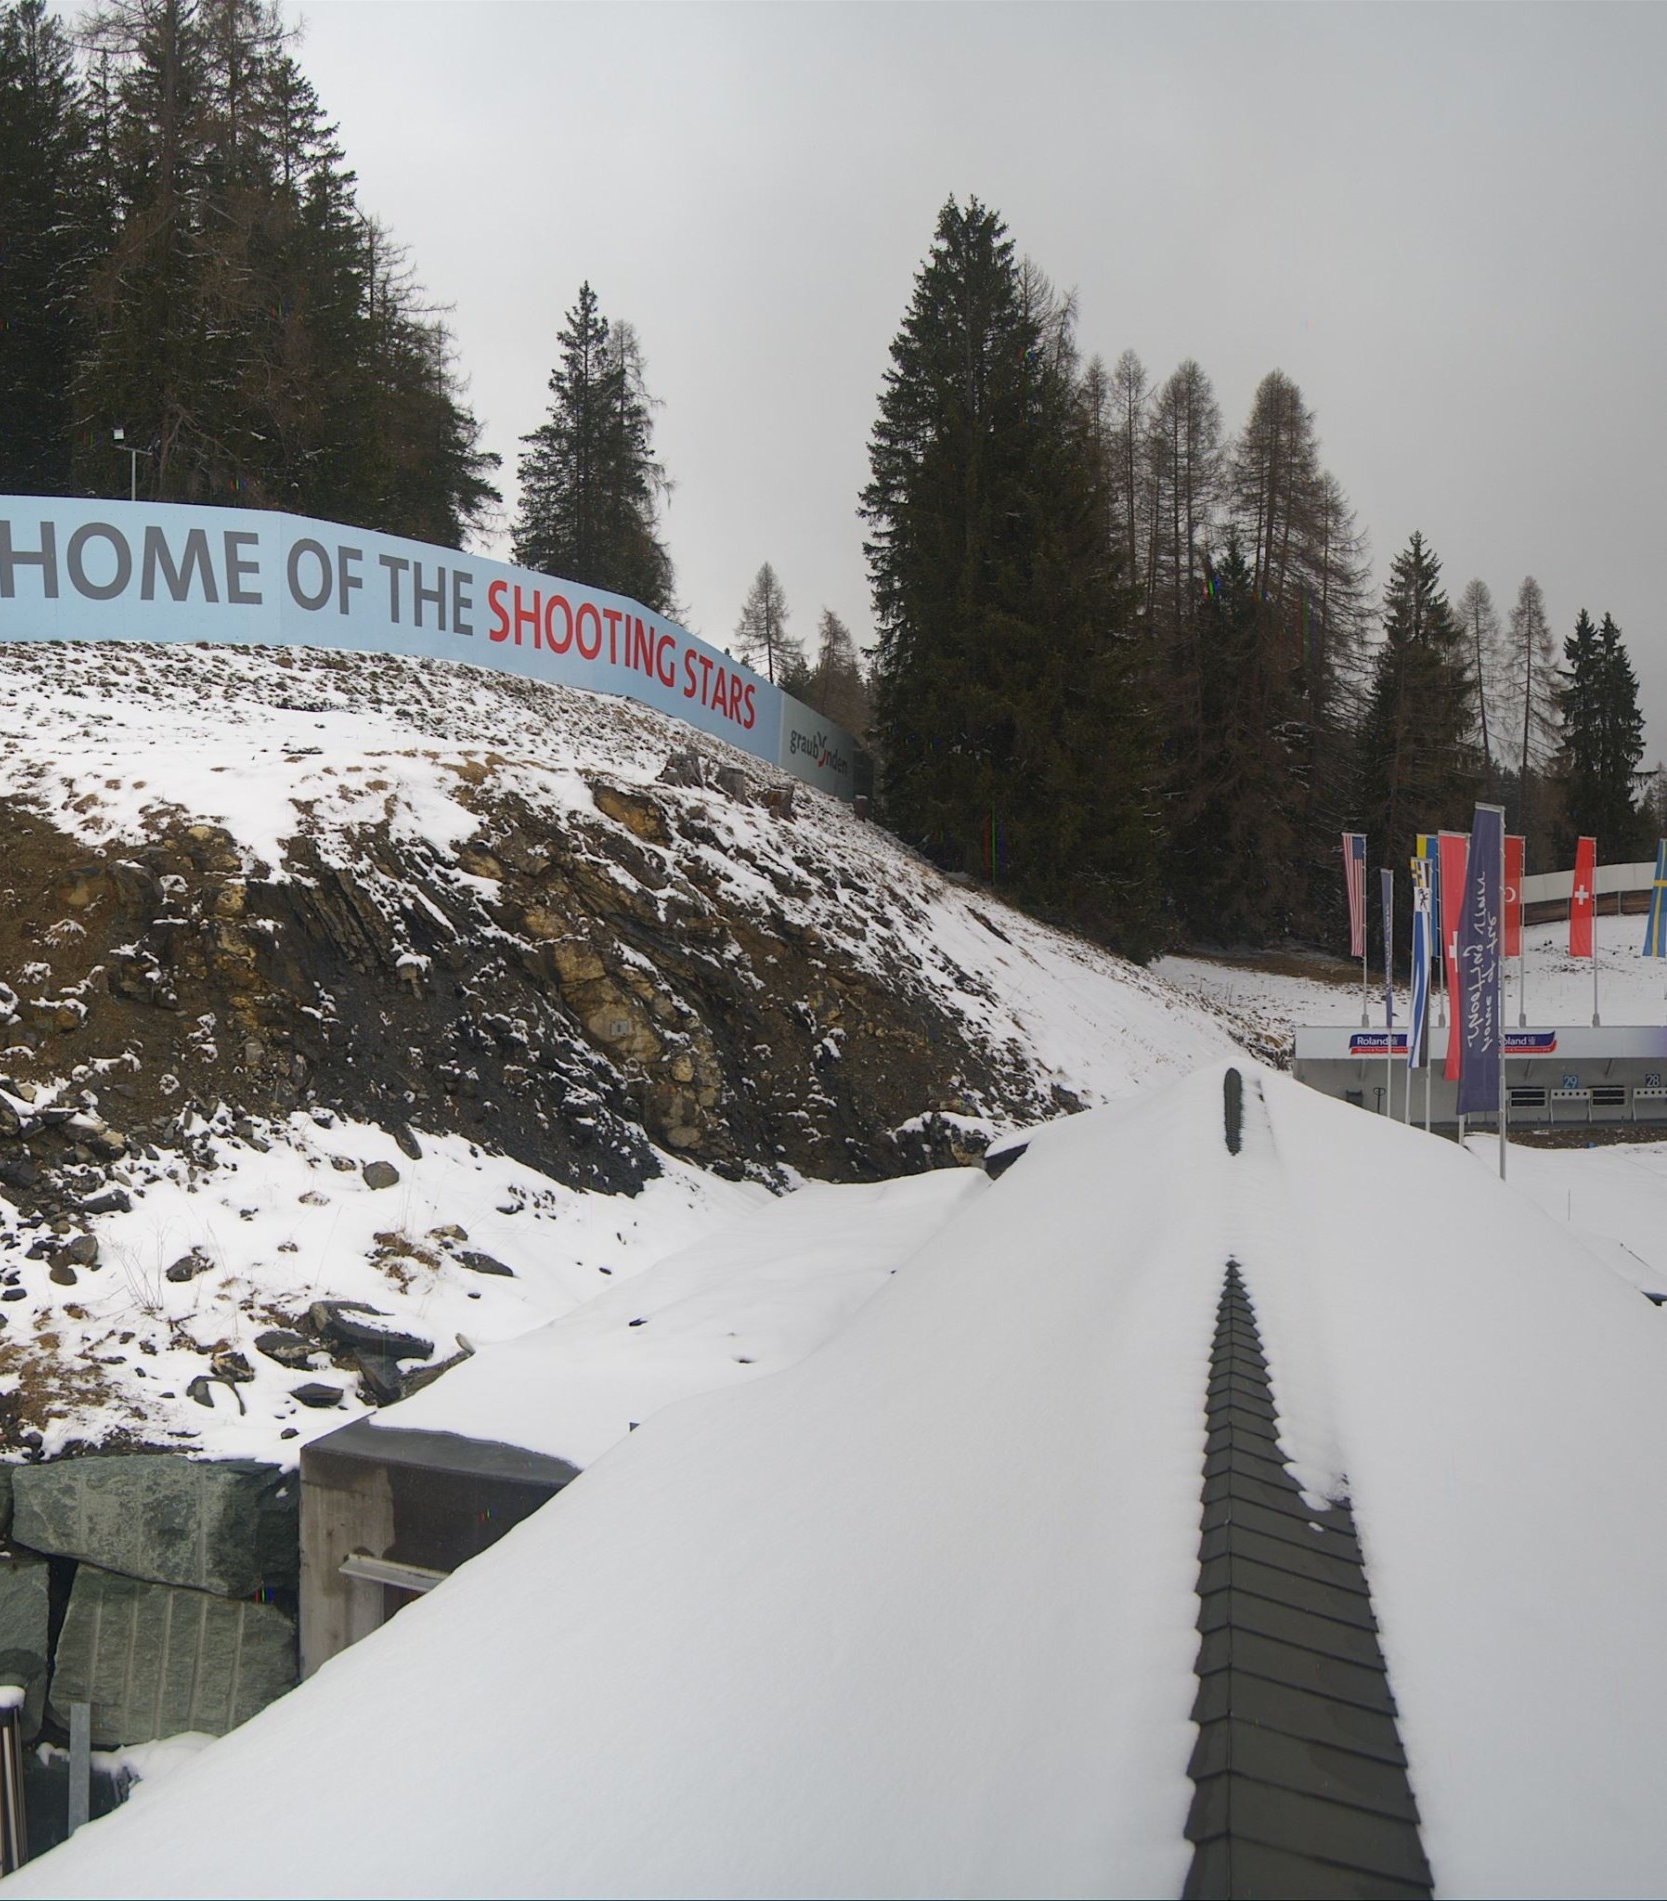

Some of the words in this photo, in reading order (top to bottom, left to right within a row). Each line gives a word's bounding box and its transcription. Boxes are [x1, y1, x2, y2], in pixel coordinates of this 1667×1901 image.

[286, 537, 363, 616] OF
[379, 553, 473, 636] THE
[488, 579, 675, 688] SHOOTING
[683, 648, 756, 730] STARS
[1564, 1075, 1577, 1089] 29
[1647, 1074, 1660, 1087] 28
